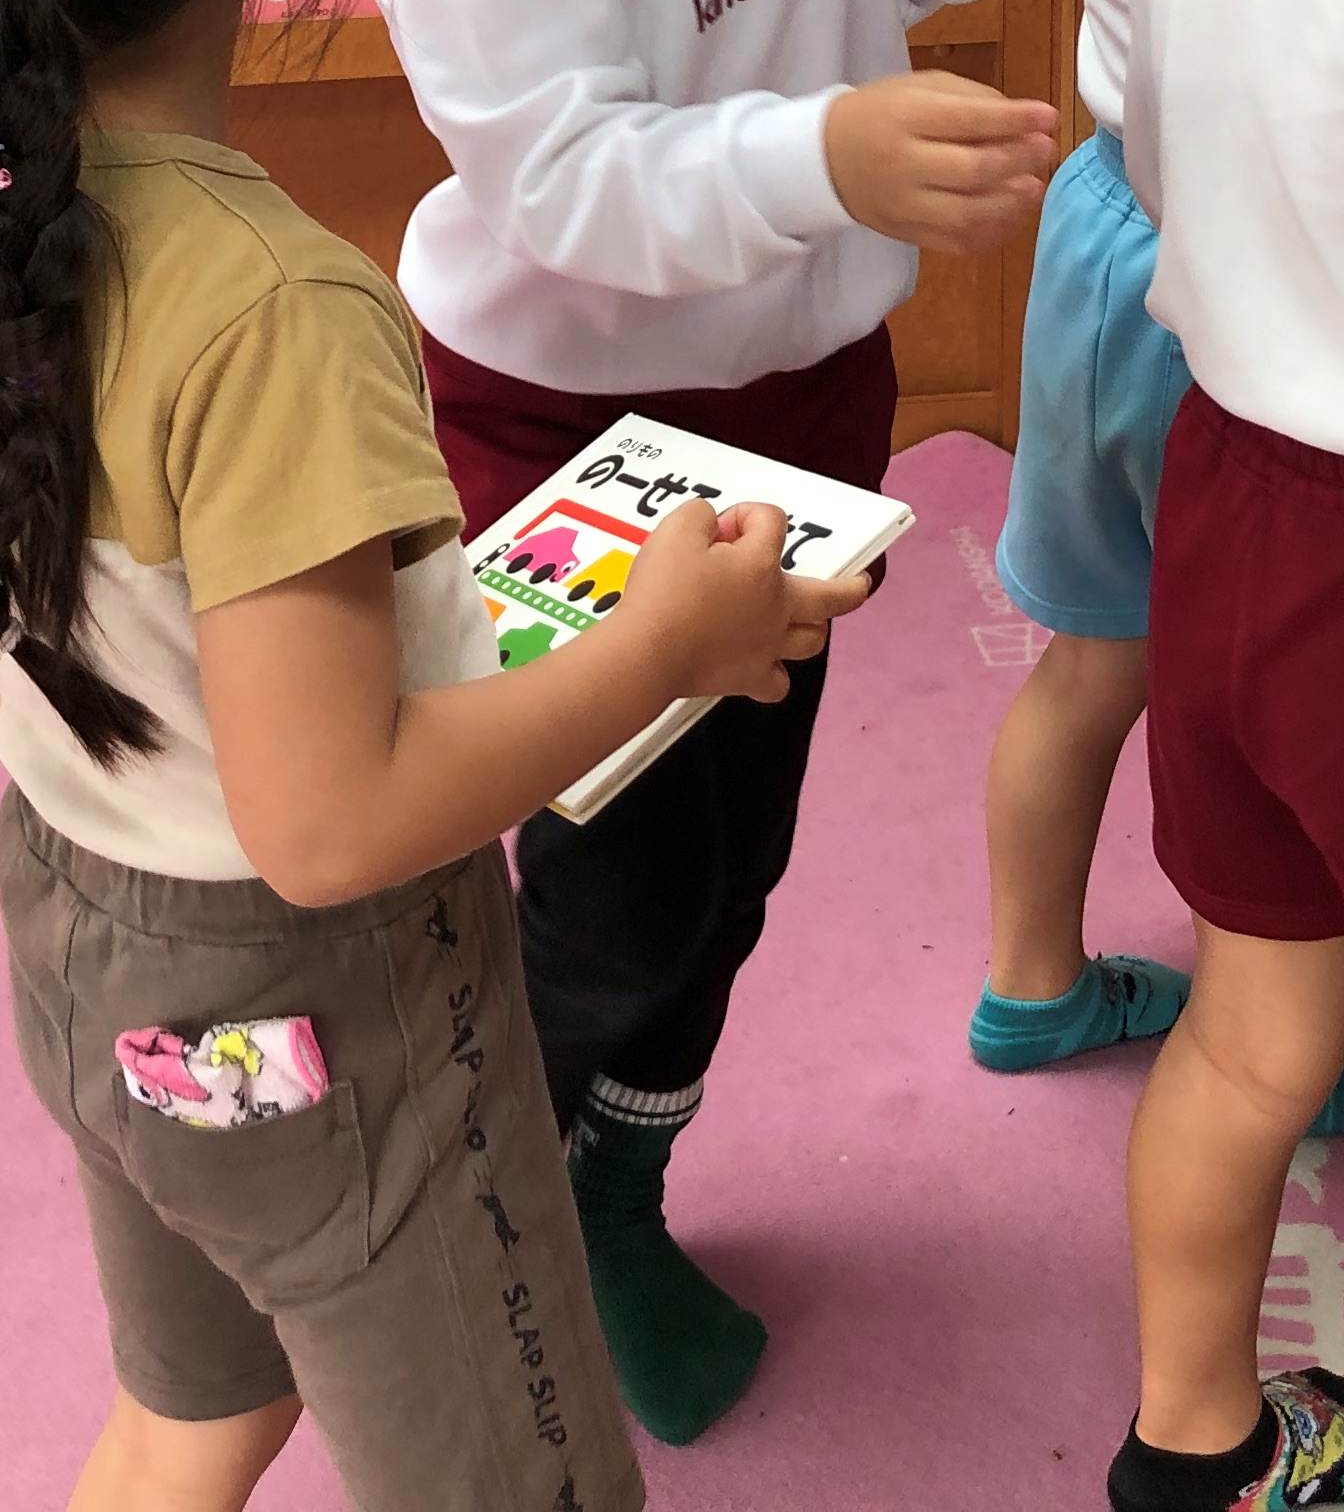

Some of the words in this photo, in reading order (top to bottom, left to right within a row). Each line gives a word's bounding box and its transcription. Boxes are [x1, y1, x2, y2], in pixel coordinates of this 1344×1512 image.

[616, 437, 663, 458] のりもの
[502, 1281, 545, 1373] SLAP
[528, 1375, 568, 1449] SLIP
